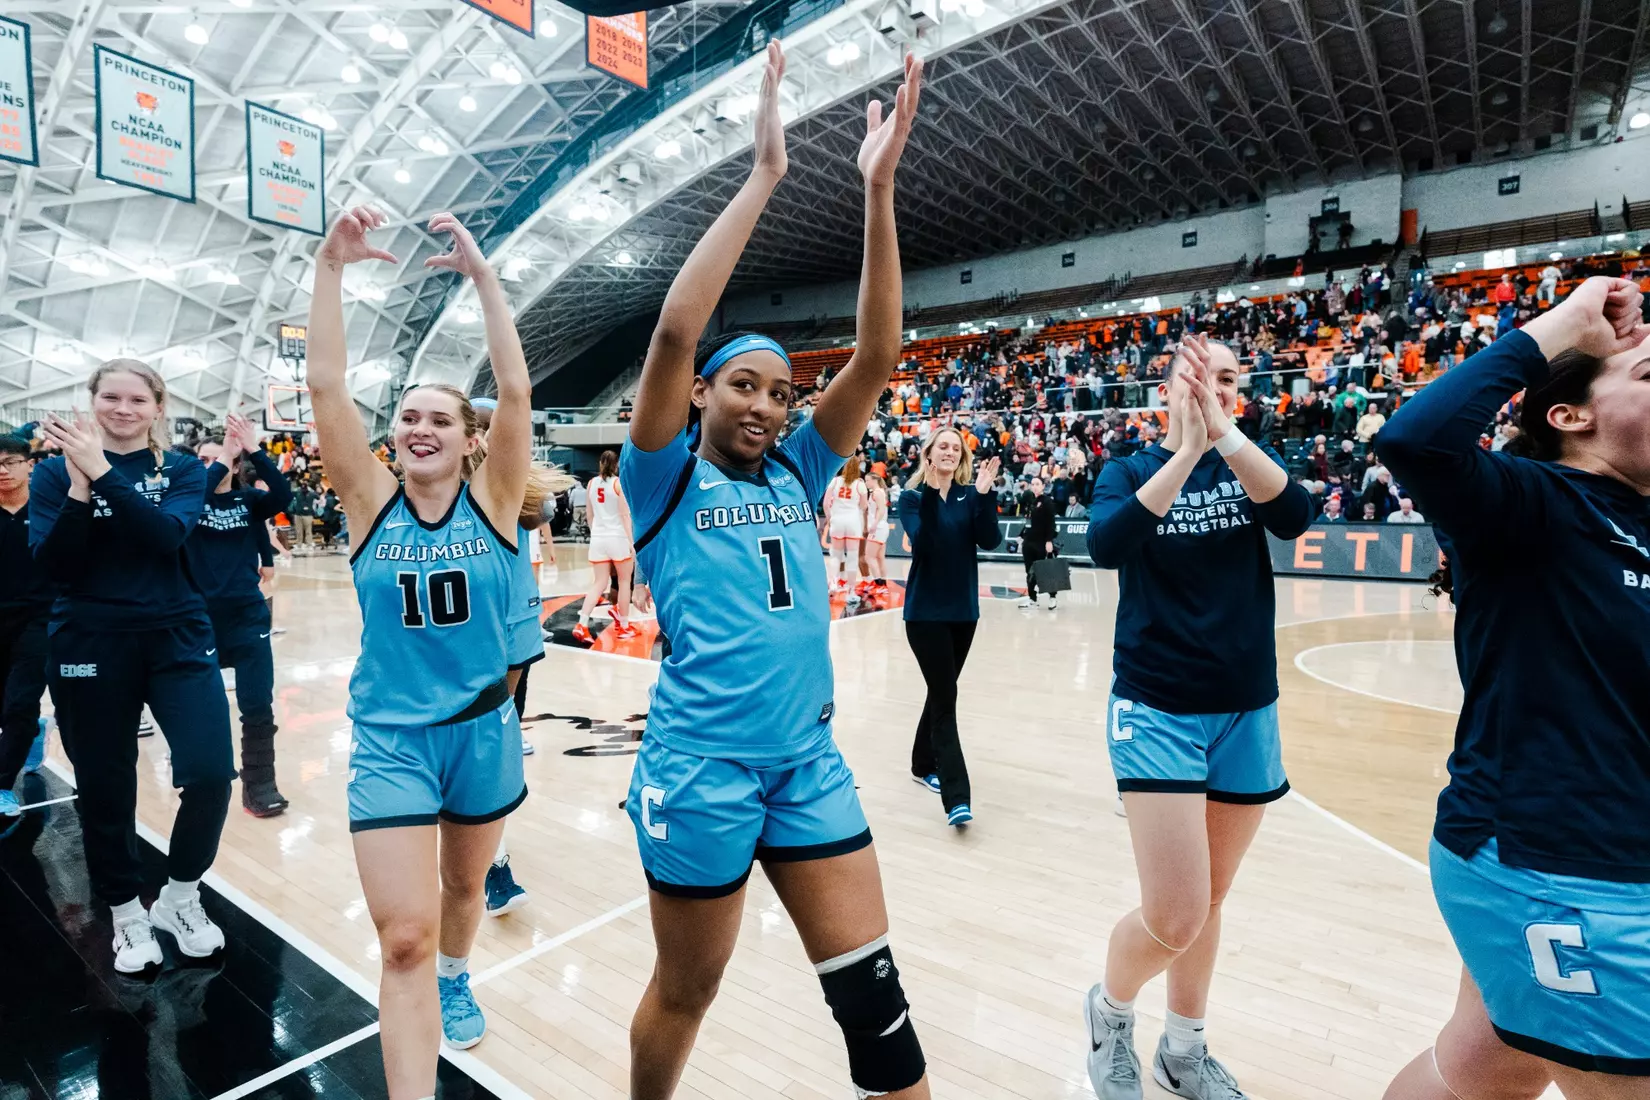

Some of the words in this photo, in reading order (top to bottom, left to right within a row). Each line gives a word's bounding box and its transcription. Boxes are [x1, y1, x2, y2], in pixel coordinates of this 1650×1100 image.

[596, 23, 617, 41] 2018
[596, 38, 618, 57] 2022
[596, 51, 618, 70] 2024
[104, 57, 186, 94] PRINCETON
[111, 120, 182, 150] CHAMPION
[128, 114, 165, 134] NCAA
[253, 111, 318, 141] PRINCETON
[259, 167, 316, 191] CHAMPION
[272, 160, 302, 177] NCAA
[597, 487, 605, 504] 5
[838, 486, 852, 499] 22
[1174, 480, 1244, 506] LUMBI
[695, 501, 813, 531] COLUMBIA
[1156, 514, 1255, 536] BASKETBAL
[1172, 503, 1240, 522] WOMEN'S
[375, 537, 490, 563] COLUMBIA
[757, 535, 795, 612] 1
[396, 568, 471, 629] 10
[60, 663, 97, 677] EDGE
[1111, 699, 1134, 743] C
[640, 784, 669, 842] C
[1522, 920, 1601, 996] C
